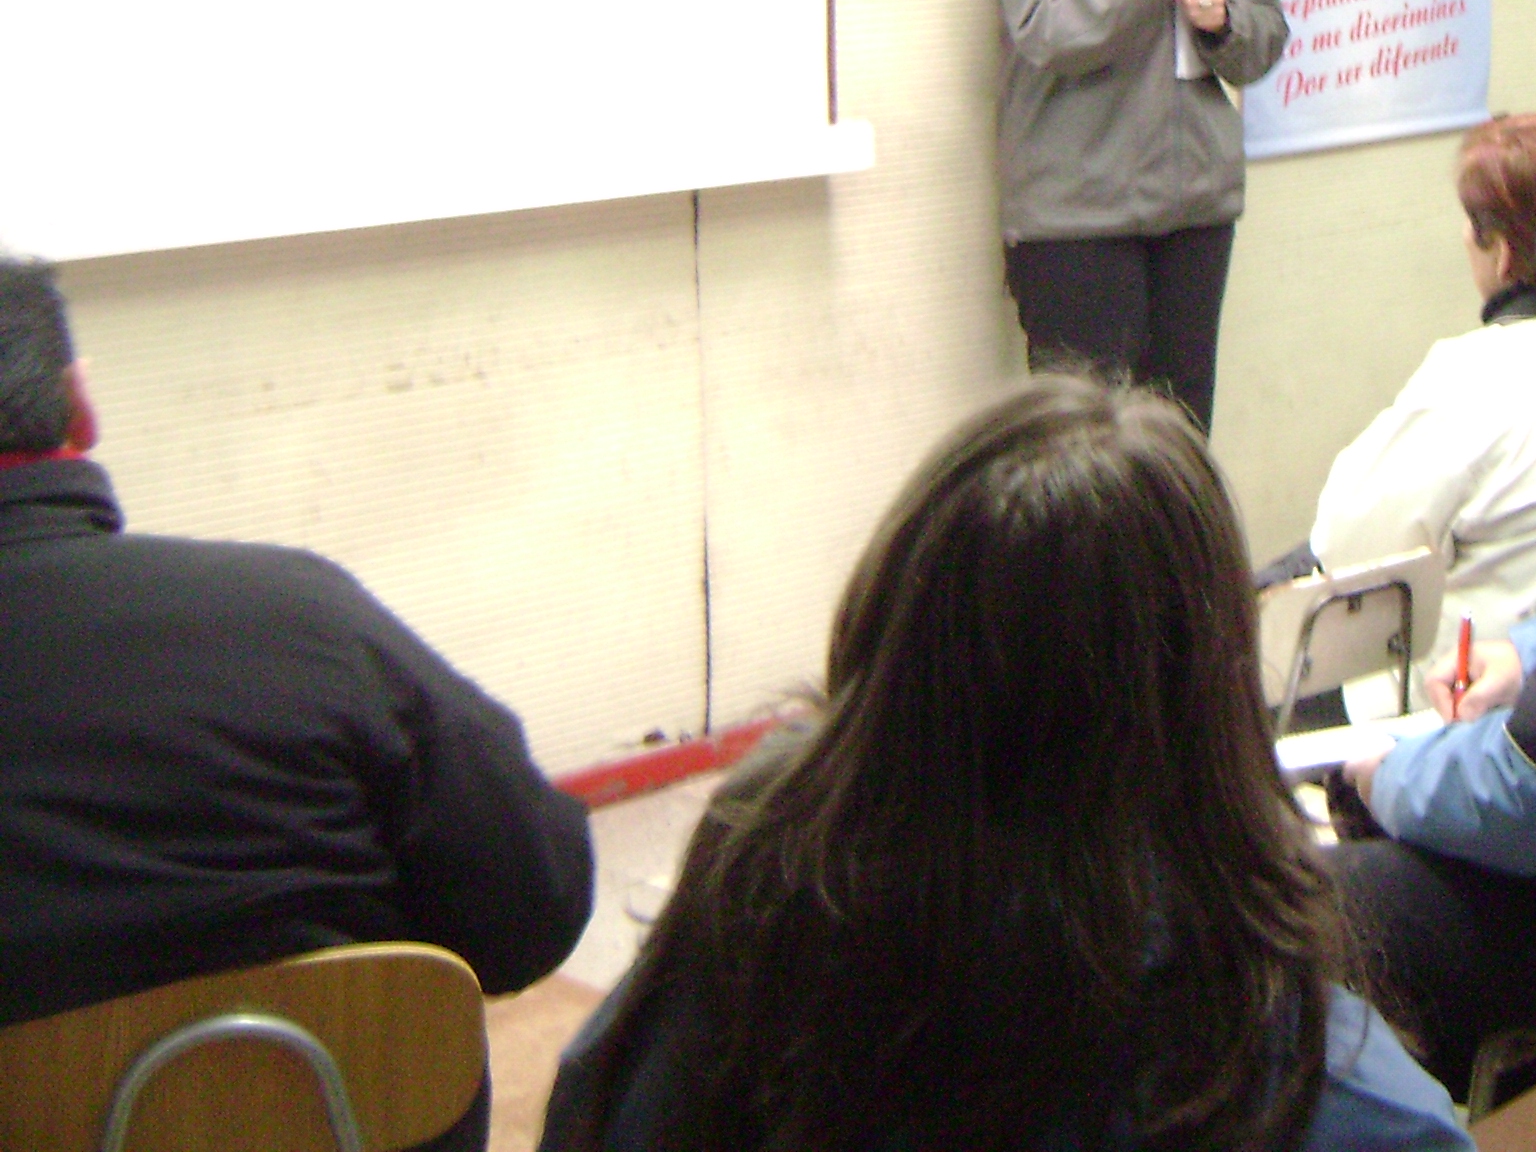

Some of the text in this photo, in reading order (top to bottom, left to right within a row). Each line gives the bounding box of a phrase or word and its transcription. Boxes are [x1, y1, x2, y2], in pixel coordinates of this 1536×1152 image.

[1312, 29, 1343, 53] me
[1276, 32, 1460, 109] Por ser diferente
